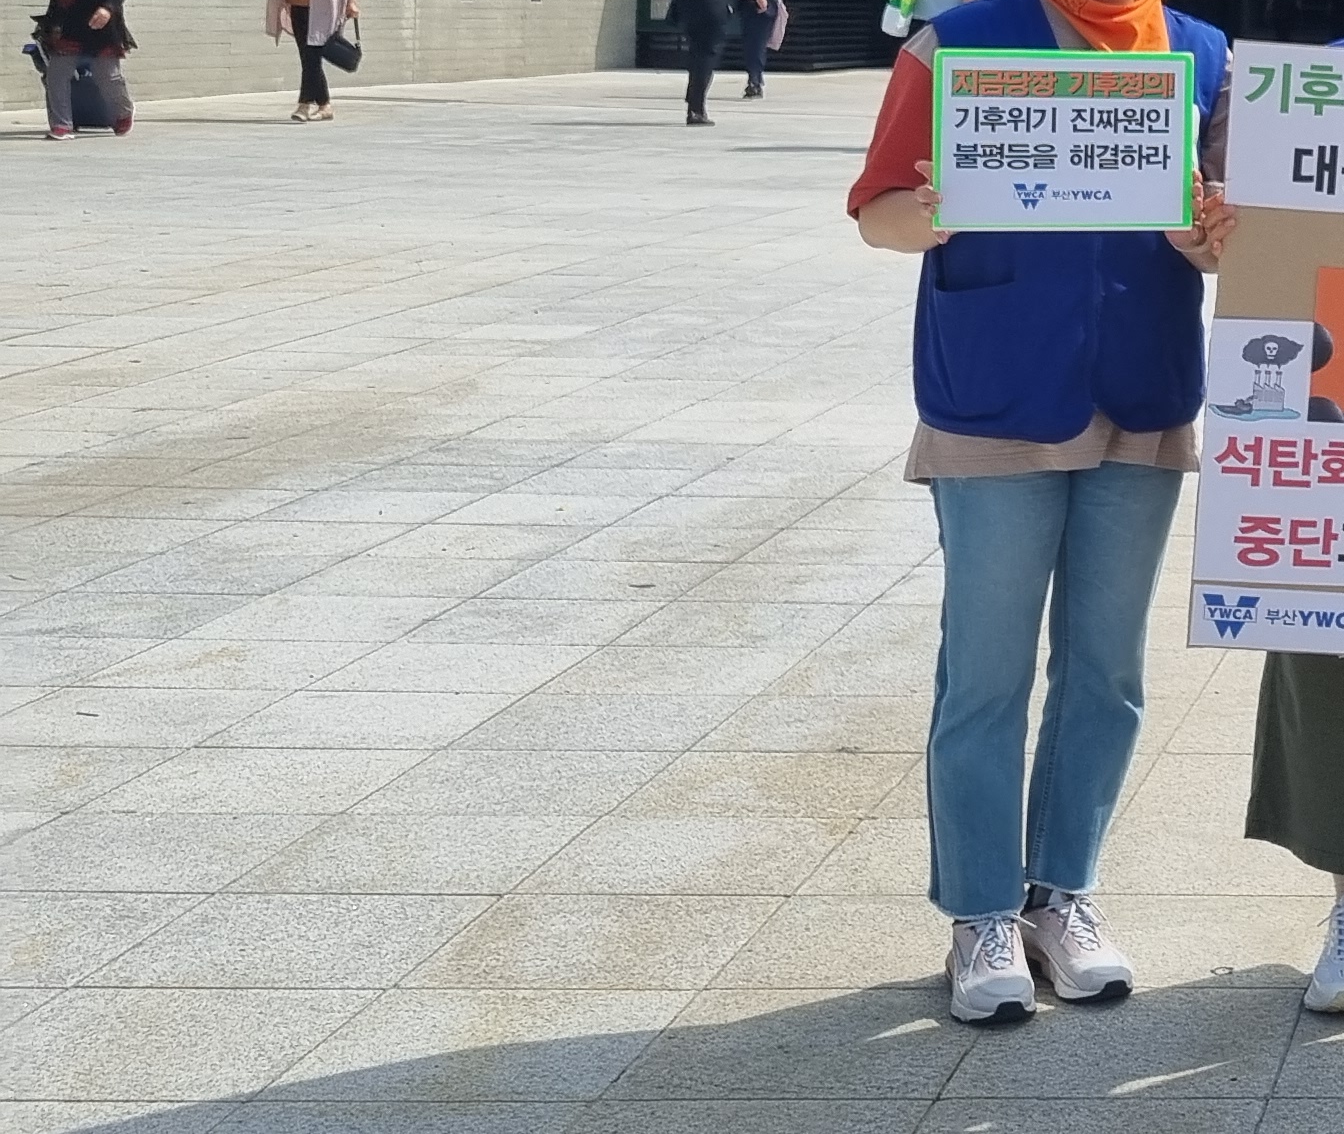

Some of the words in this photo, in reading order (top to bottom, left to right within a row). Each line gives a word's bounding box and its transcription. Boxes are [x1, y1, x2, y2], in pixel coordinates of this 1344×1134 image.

[953, 70, 1058, 97] 지금당장
[1068, 72, 1175, 99] 기후정의!
[954, 106, 1057, 134] 기후위기
[1070, 107, 1171, 134] 진짜원인
[953, 143, 1058, 170] 불평등을
[1070, 144, 1171, 170] 해결하라
[1051, 189, 1112, 201] 부산YWCA
[1207, 606, 1254, 621] YWCA
